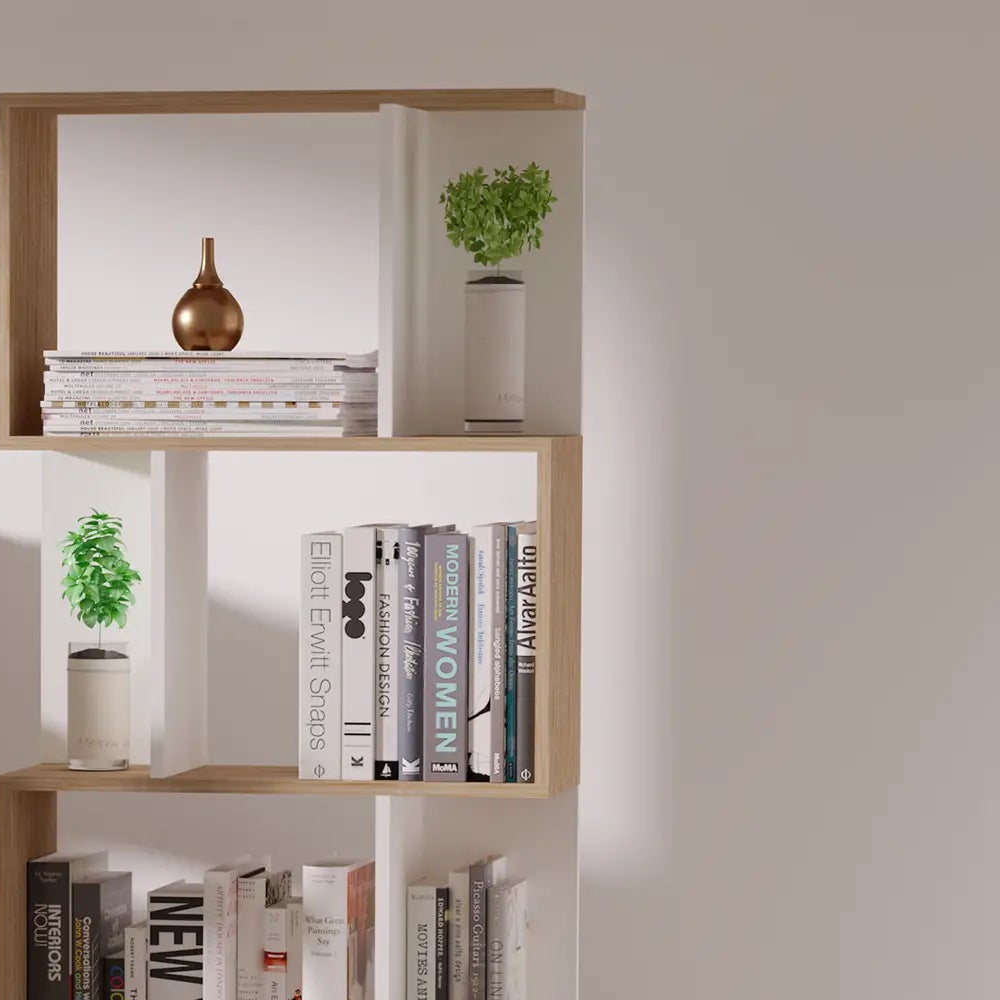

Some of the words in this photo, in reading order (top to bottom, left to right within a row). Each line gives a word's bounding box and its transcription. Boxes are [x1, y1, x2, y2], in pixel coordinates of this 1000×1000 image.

[309, 541, 332, 599] Elliott
[445, 544, 459, 621] MODERN
[517, 546, 537, 598] Aalto
[309, 608, 332, 669] Erwitt
[379, 594, 391, 658] FASHION
[493, 627, 502, 659] tangled
[517, 600, 536, 650] Alvar
[379, 661, 391, 718] DESIGN
[435, 625, 457, 753] WOMEN
[493, 660, 502, 700] alphabets
[306, 679, 332, 751] Snaps
[432, 763, 458, 772] MoMA
[493, 752, 501, 774] MoMA
[34, 904, 48, 948] NOW!
[473, 880, 484, 922] Picasso
[48, 904, 61, 981] INTERIORS
[74, 917, 82, 938] John
[82, 916, 92, 989] Conversations
[149, 897, 204, 984] NEW
[416, 924, 428, 976] MOVIES
[472, 924, 483, 968] Guitars
[489, 940, 504, 964] ON
[74, 973, 82, 990] and
[271, 981, 278, 994] An
